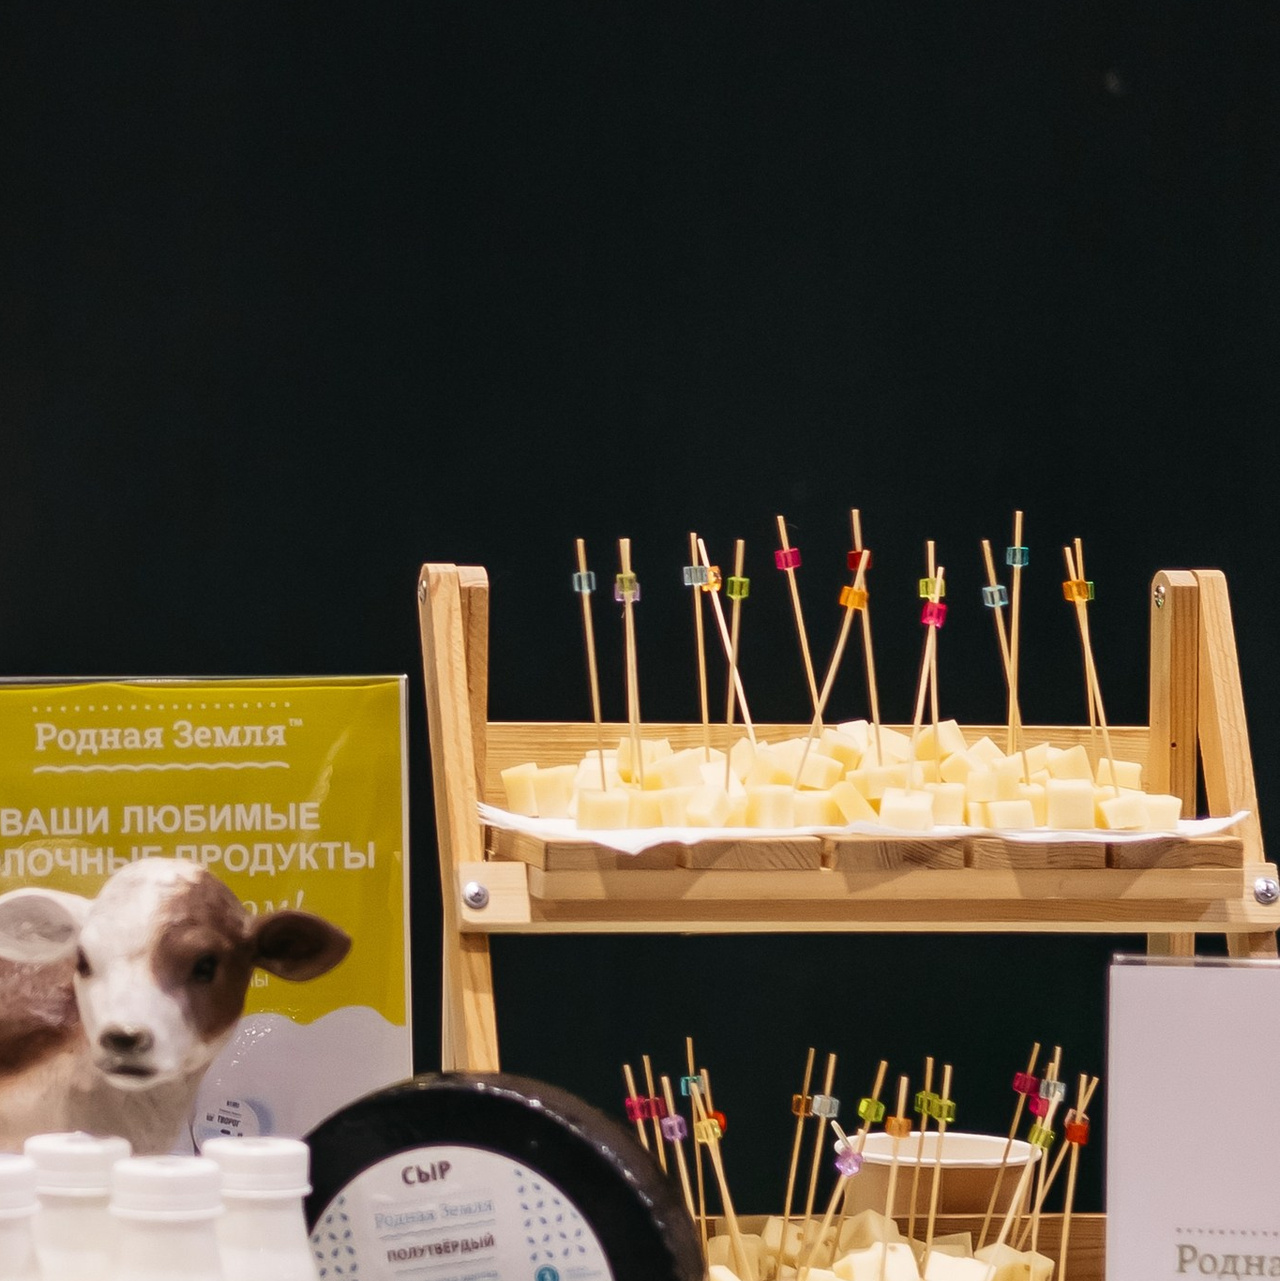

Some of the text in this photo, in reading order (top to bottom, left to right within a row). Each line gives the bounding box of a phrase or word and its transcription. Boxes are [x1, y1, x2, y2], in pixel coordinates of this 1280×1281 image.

[34, 721, 165, 755] Родная
[0, 801, 321, 837] ВАШИ ЛЮБИМЫЕ
[401, 1160, 452, 1186] СЫР
[386, 1233, 496, 1263] ПОЛУТВЁРДЫЙ
